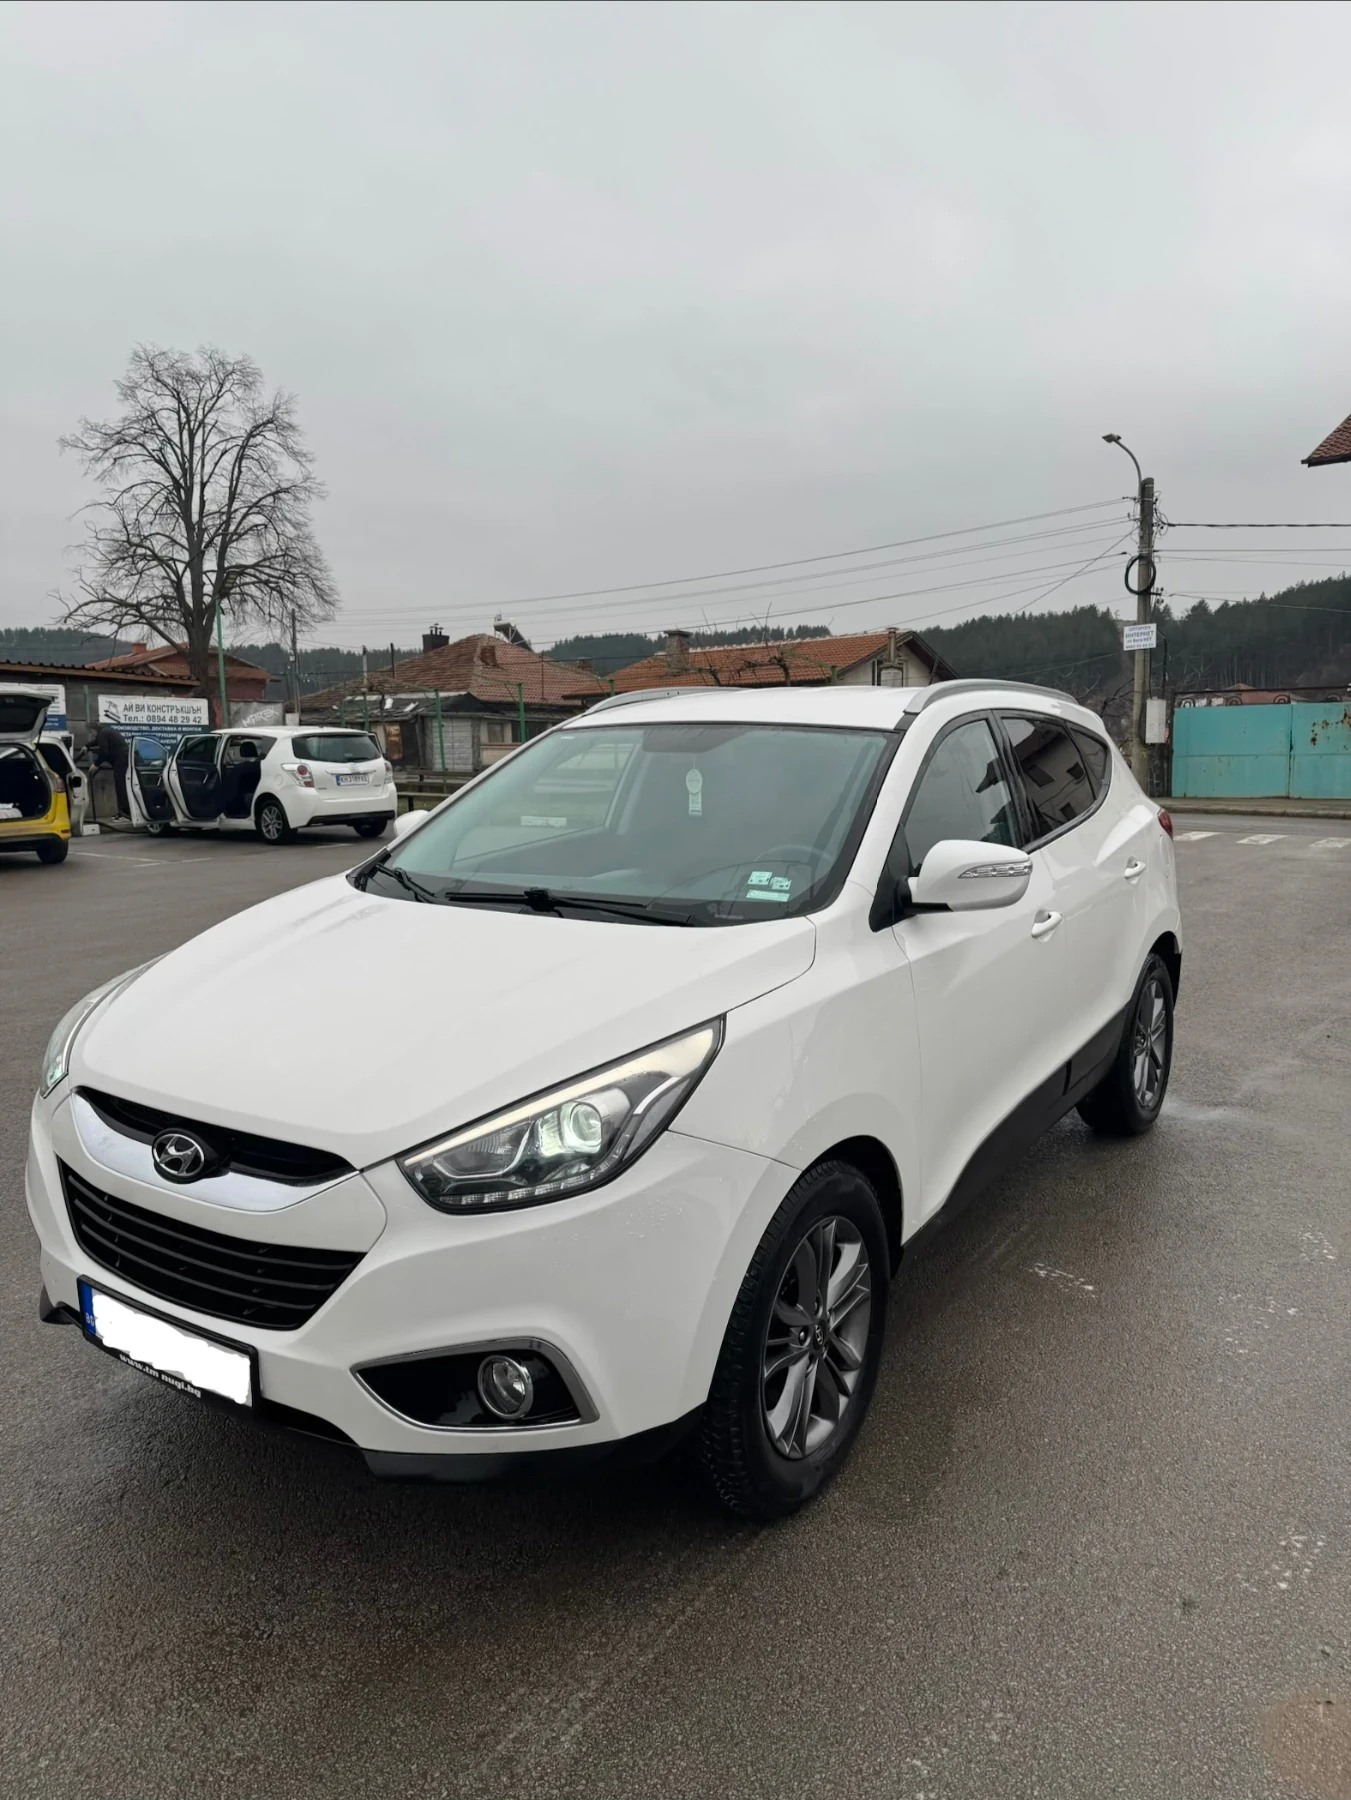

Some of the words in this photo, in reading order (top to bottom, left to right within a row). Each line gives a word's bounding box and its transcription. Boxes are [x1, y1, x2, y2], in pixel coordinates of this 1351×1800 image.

[1125, 630, 1154, 638] ИНТЕРНЕТ
[123, 702, 134, 712] АЙ
[135, 704, 146, 712] ВИ
[147, 704, 202, 714] КОНСТРЪКШЪН
[146, 715, 166, 723] 0894
[85, 1313, 95, 1327] BG
